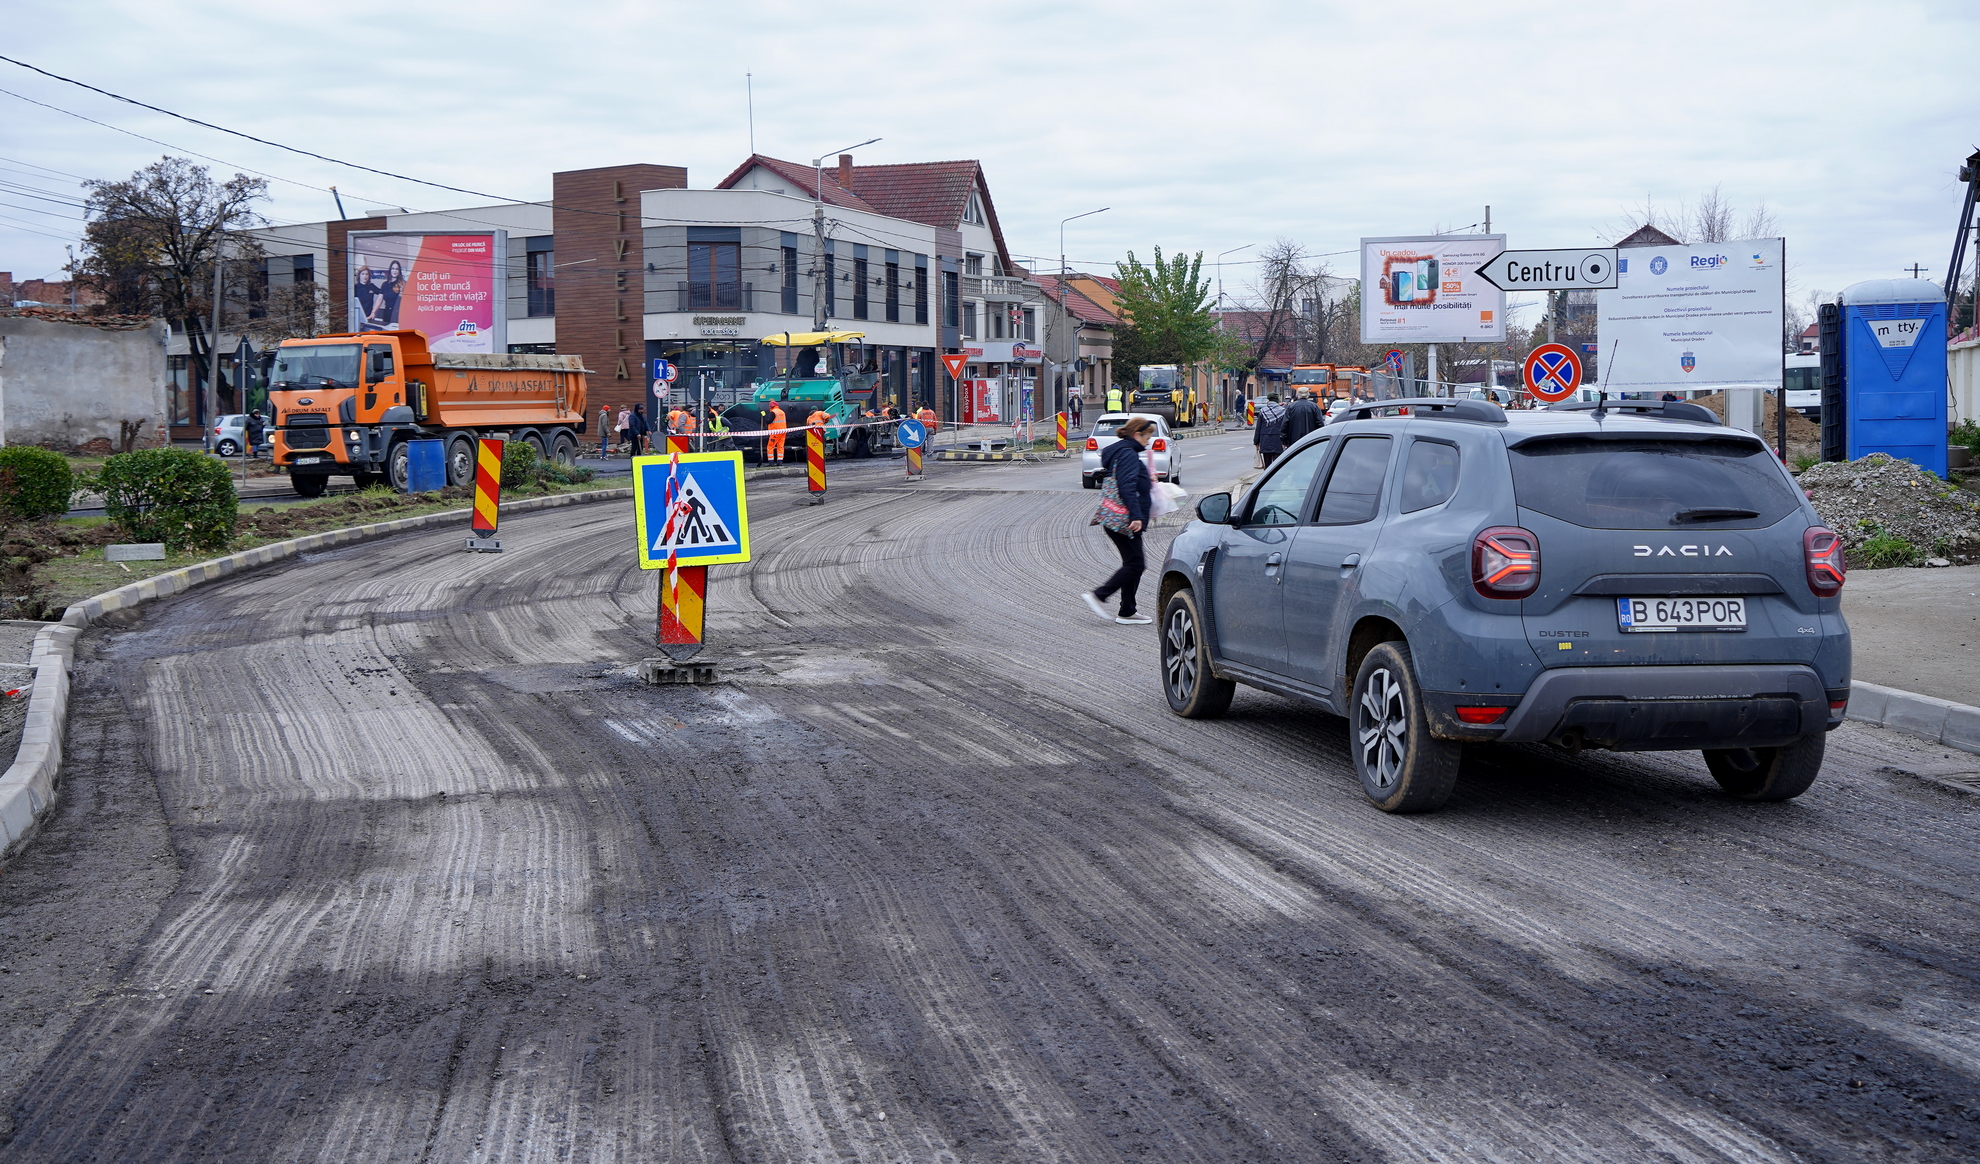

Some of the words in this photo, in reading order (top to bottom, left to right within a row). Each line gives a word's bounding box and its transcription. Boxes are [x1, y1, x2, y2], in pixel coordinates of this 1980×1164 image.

[1691, 254, 1728, 268] Regio
[1508, 261, 1575, 282] Centru
[613, 180, 630, 380] LIVELLA
[417, 282, 428, 290] loc
[431, 282, 441, 290] de
[443, 281, 470, 290] muncă
[417, 293, 447, 302] inspirat
[449, 292, 462, 300] din
[1433, 302, 1472, 310] posibilități
[693, 316, 746, 325] SUPERMARKET
[460, 321, 475, 331] dm
[521, 380, 552, 391] ASFALT
[1633, 545, 1733, 556] DACIA
[1632, 601, 1648, 622] B
[1656, 601, 1742, 622] 643POR
[1621, 614, 1631, 623] RO
